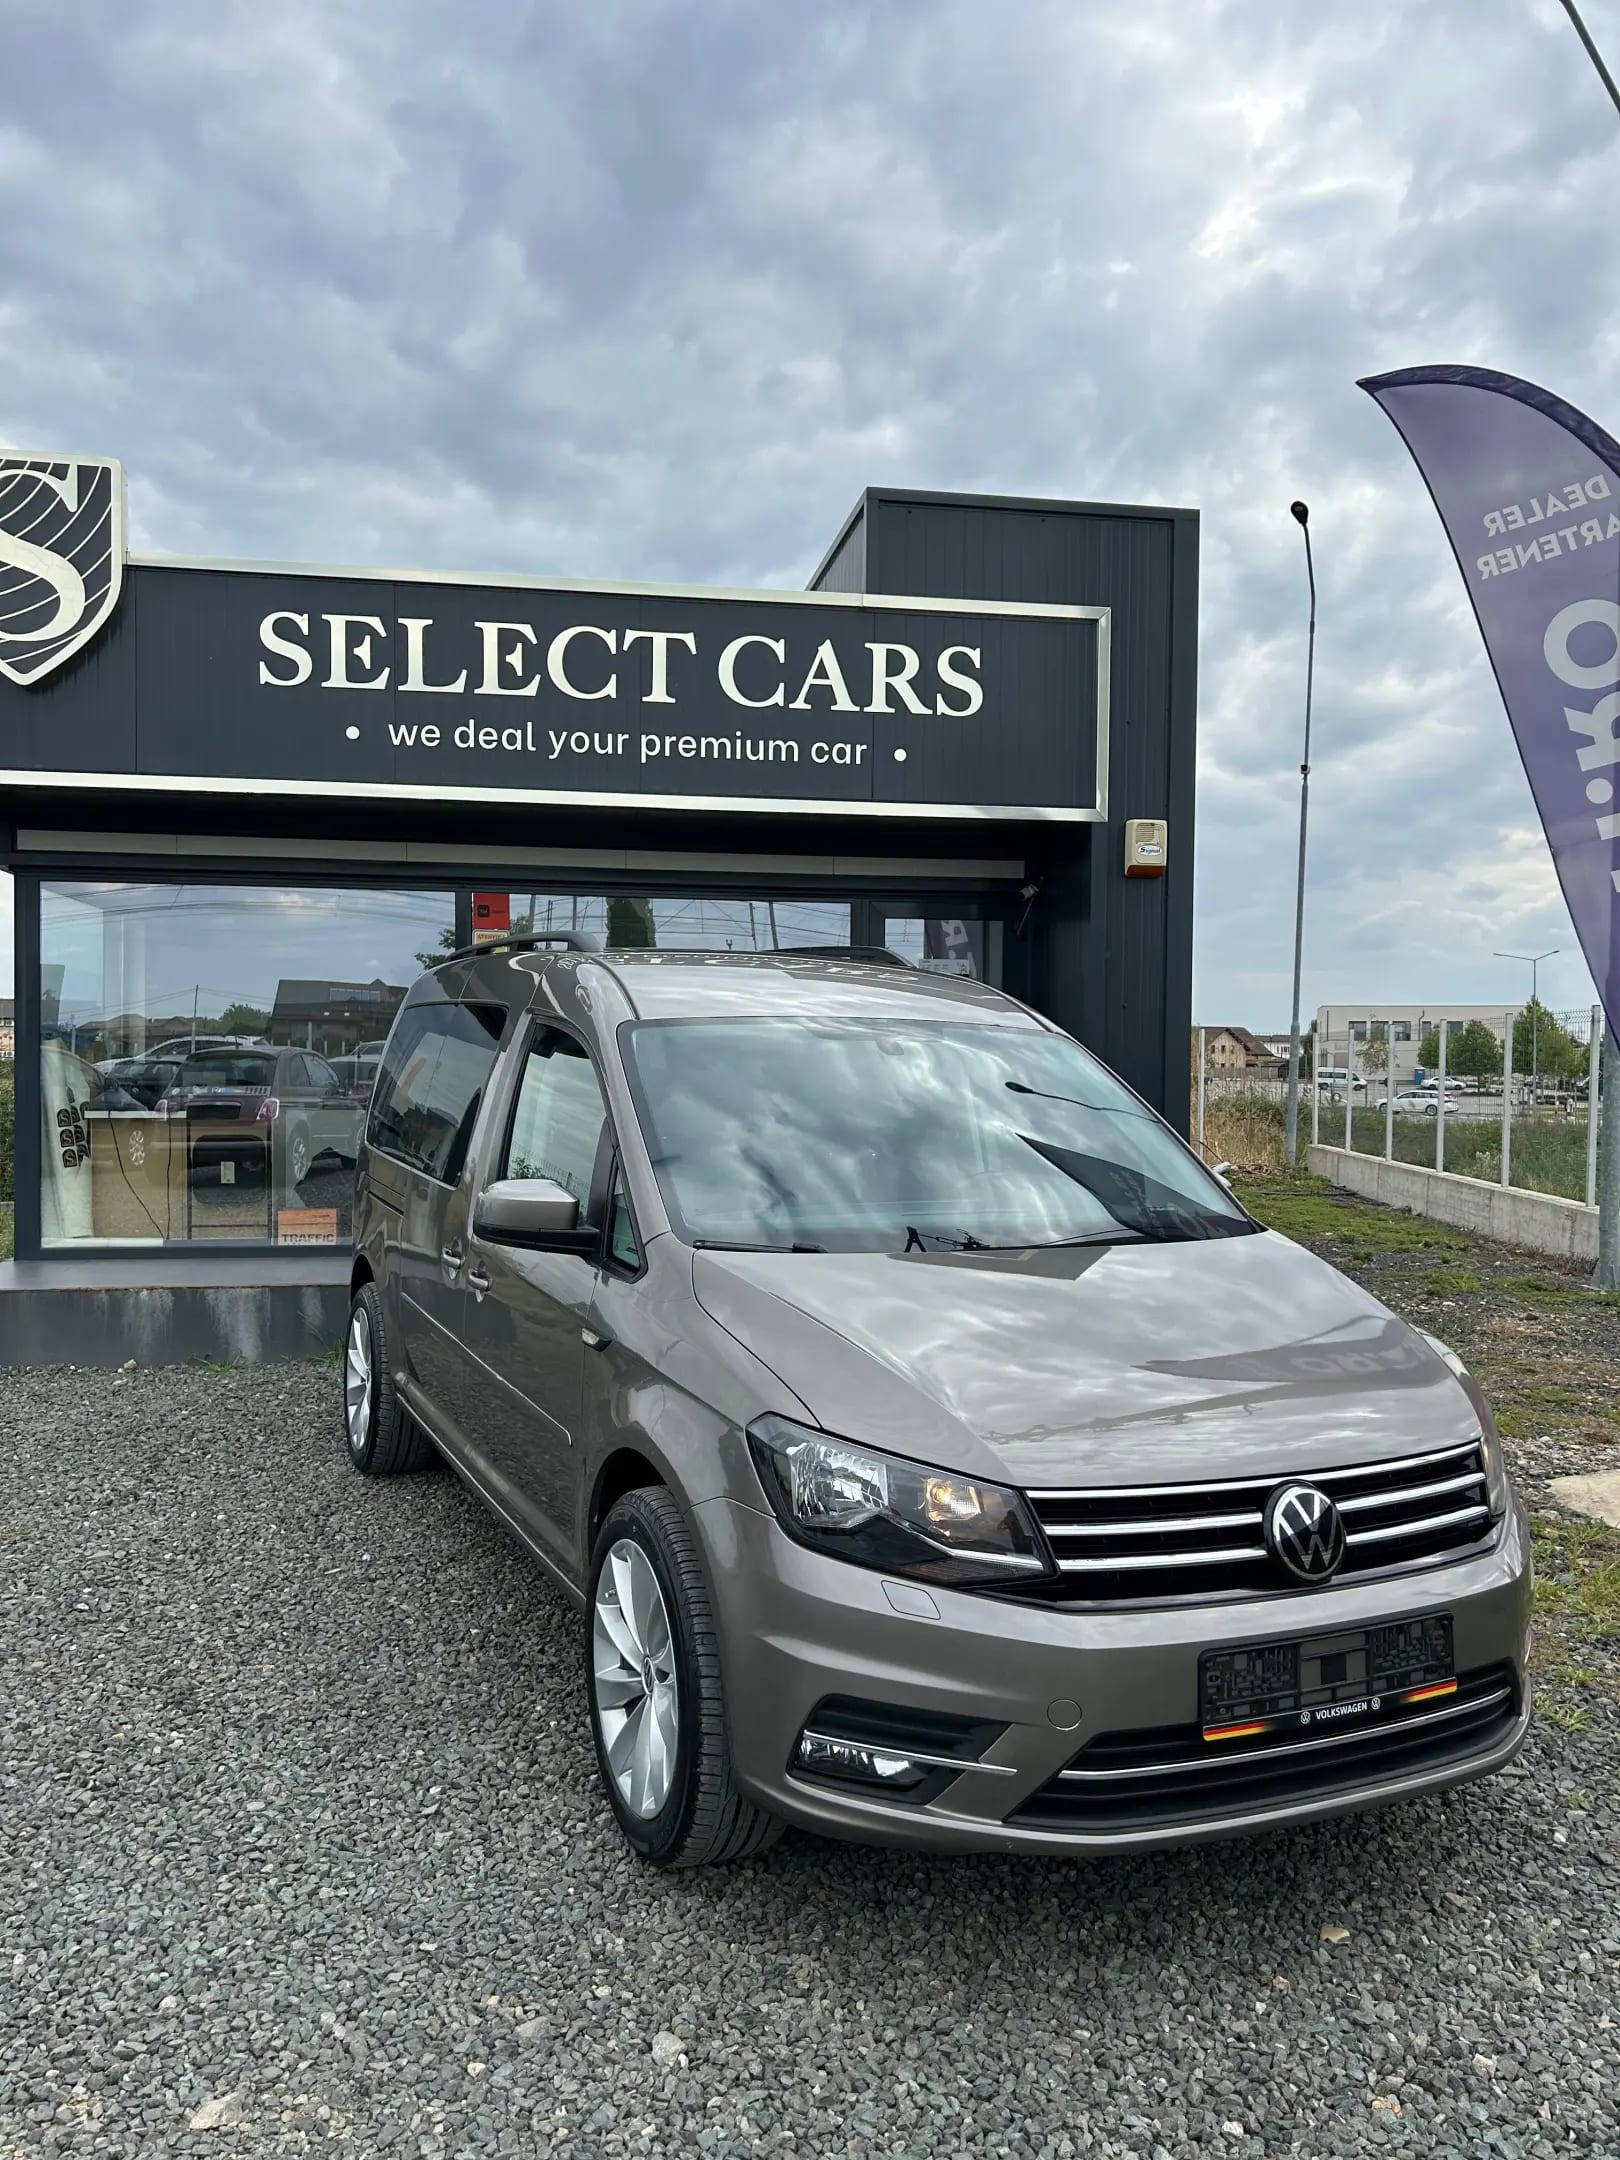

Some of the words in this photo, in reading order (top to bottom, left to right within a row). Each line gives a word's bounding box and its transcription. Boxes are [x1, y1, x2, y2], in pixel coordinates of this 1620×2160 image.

[259, 611, 698, 704] SELECT
[717, 635, 985, 717] CARS
[388, 723, 441, 747] we
[453, 717, 537, 752] deal
[546, 729, 630, 764] your
[640, 731, 799, 765] premium
[810, 742, 868, 765] car
[281, 1233, 334, 1243] TRAFFIC
[1315, 1701, 1368, 1720] VOLKSWAGEN
